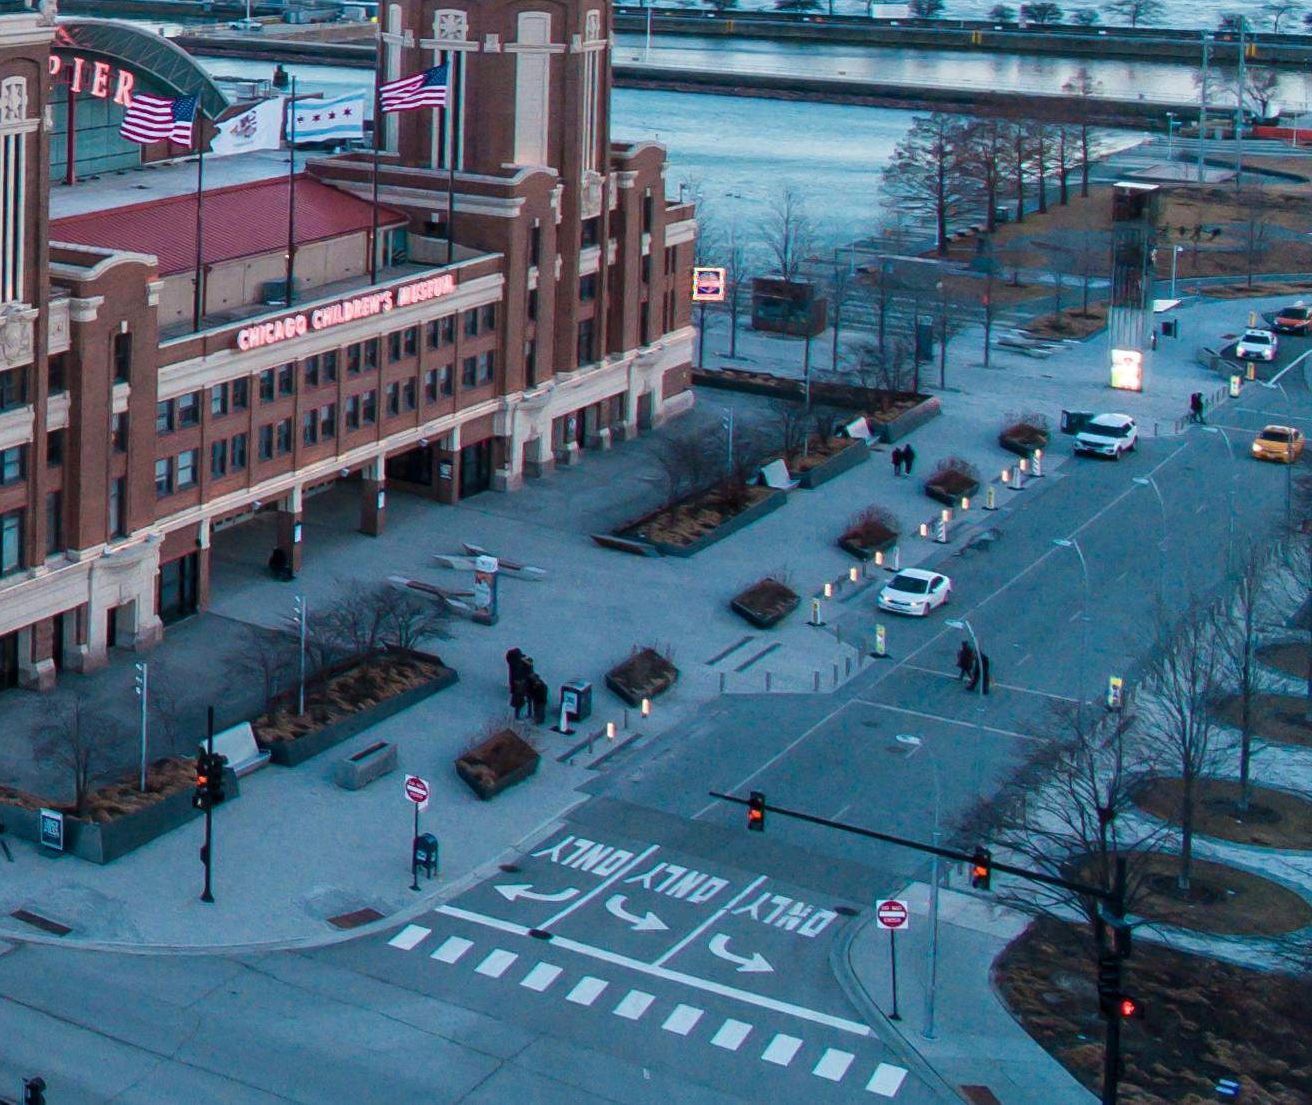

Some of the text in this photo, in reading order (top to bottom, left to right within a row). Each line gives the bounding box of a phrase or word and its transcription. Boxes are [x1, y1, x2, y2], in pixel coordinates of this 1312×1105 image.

[48, 54, 134, 108] PIER
[237, 274, 456, 351] CHICAGO CHILDREN'S MUSEUM
[531, 836, 634, 877] ONLY
[623, 862, 729, 904] ONLY
[731, 891, 839, 938] ONLY
